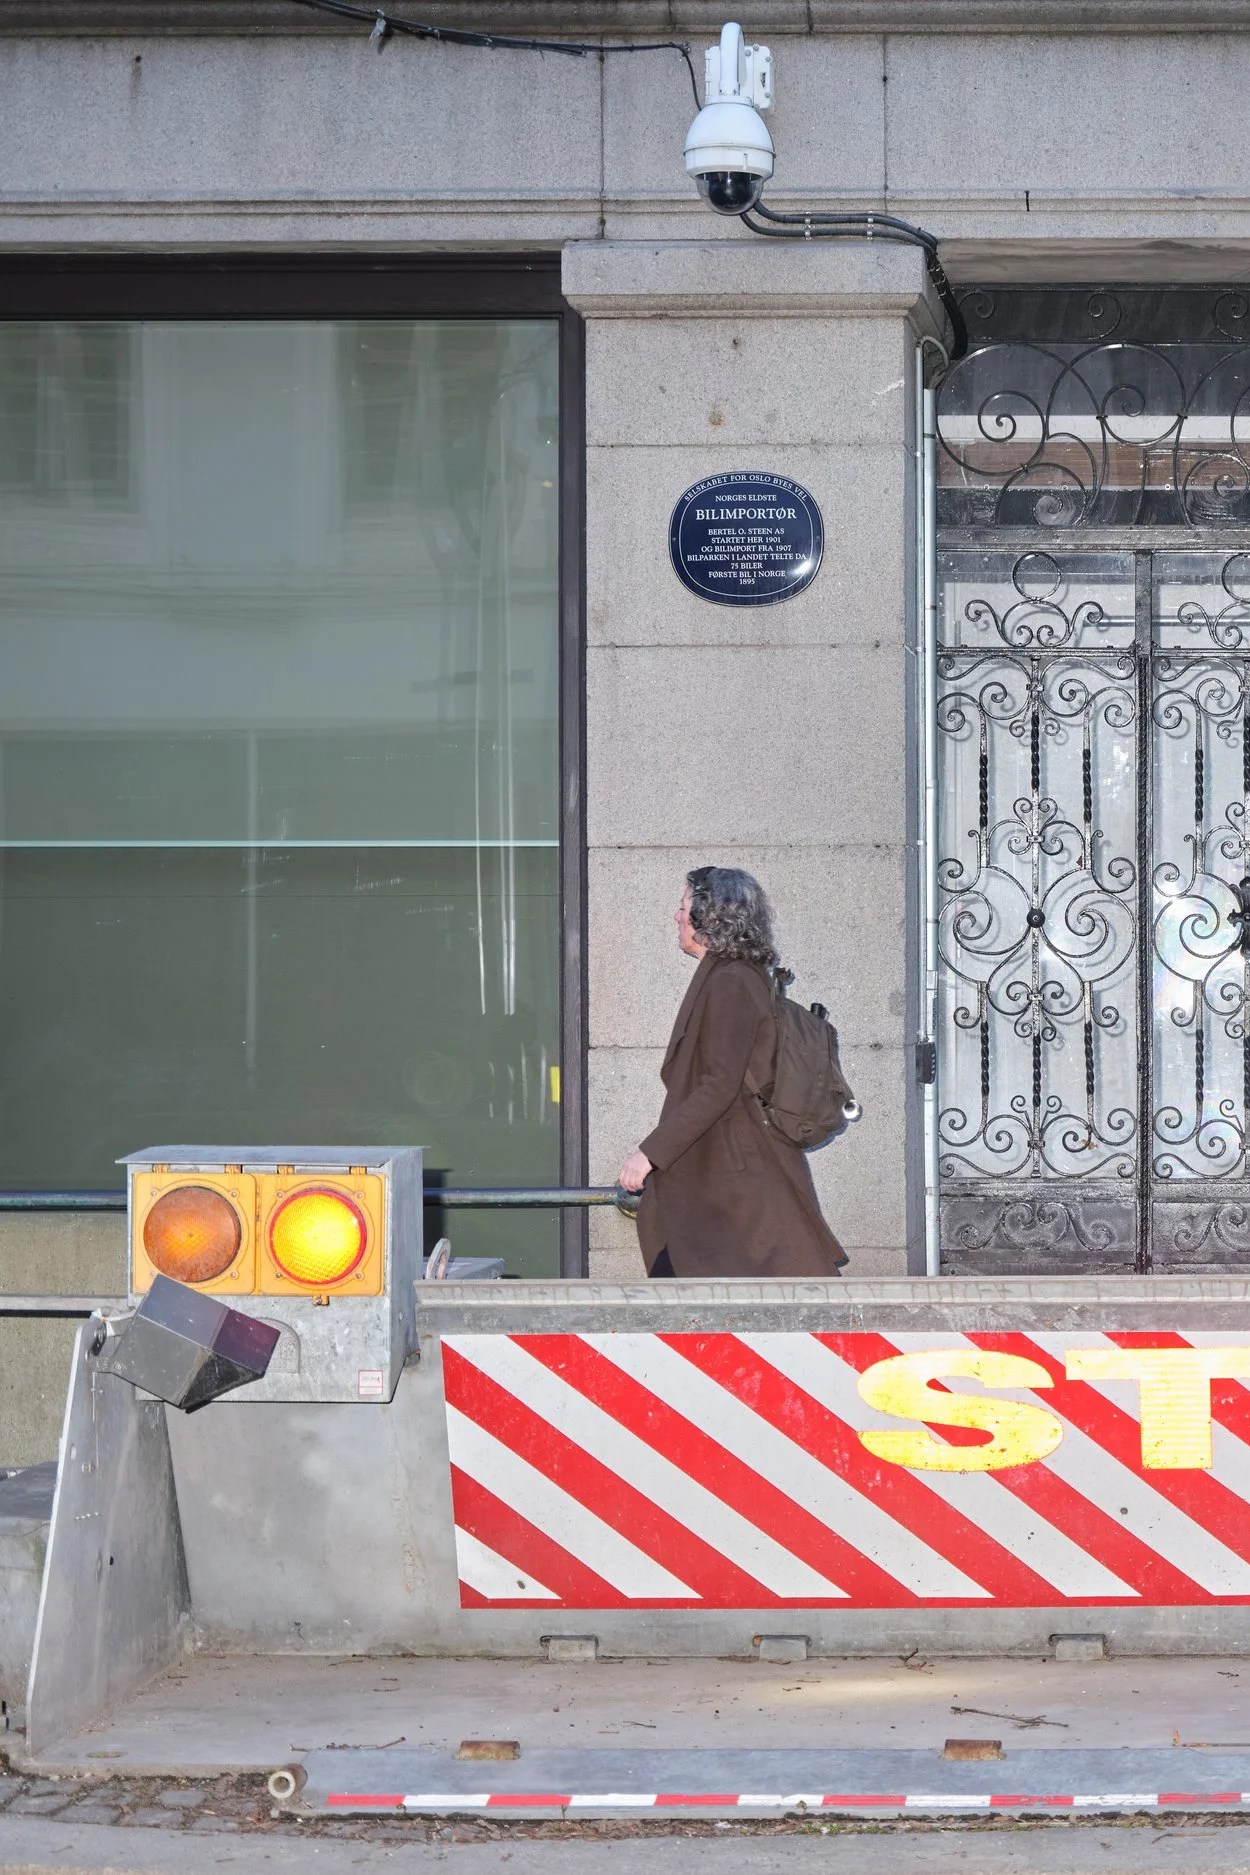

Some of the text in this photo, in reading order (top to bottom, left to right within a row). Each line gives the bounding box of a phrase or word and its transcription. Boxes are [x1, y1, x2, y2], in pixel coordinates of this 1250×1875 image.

[684, 475, 727, 501] SELSKABET
[749, 474, 771, 482] OSLO
[773, 477, 793, 489] BYES
[794, 487, 807, 501] VEL
[696, 507, 796, 520] BILIMPORTØR
